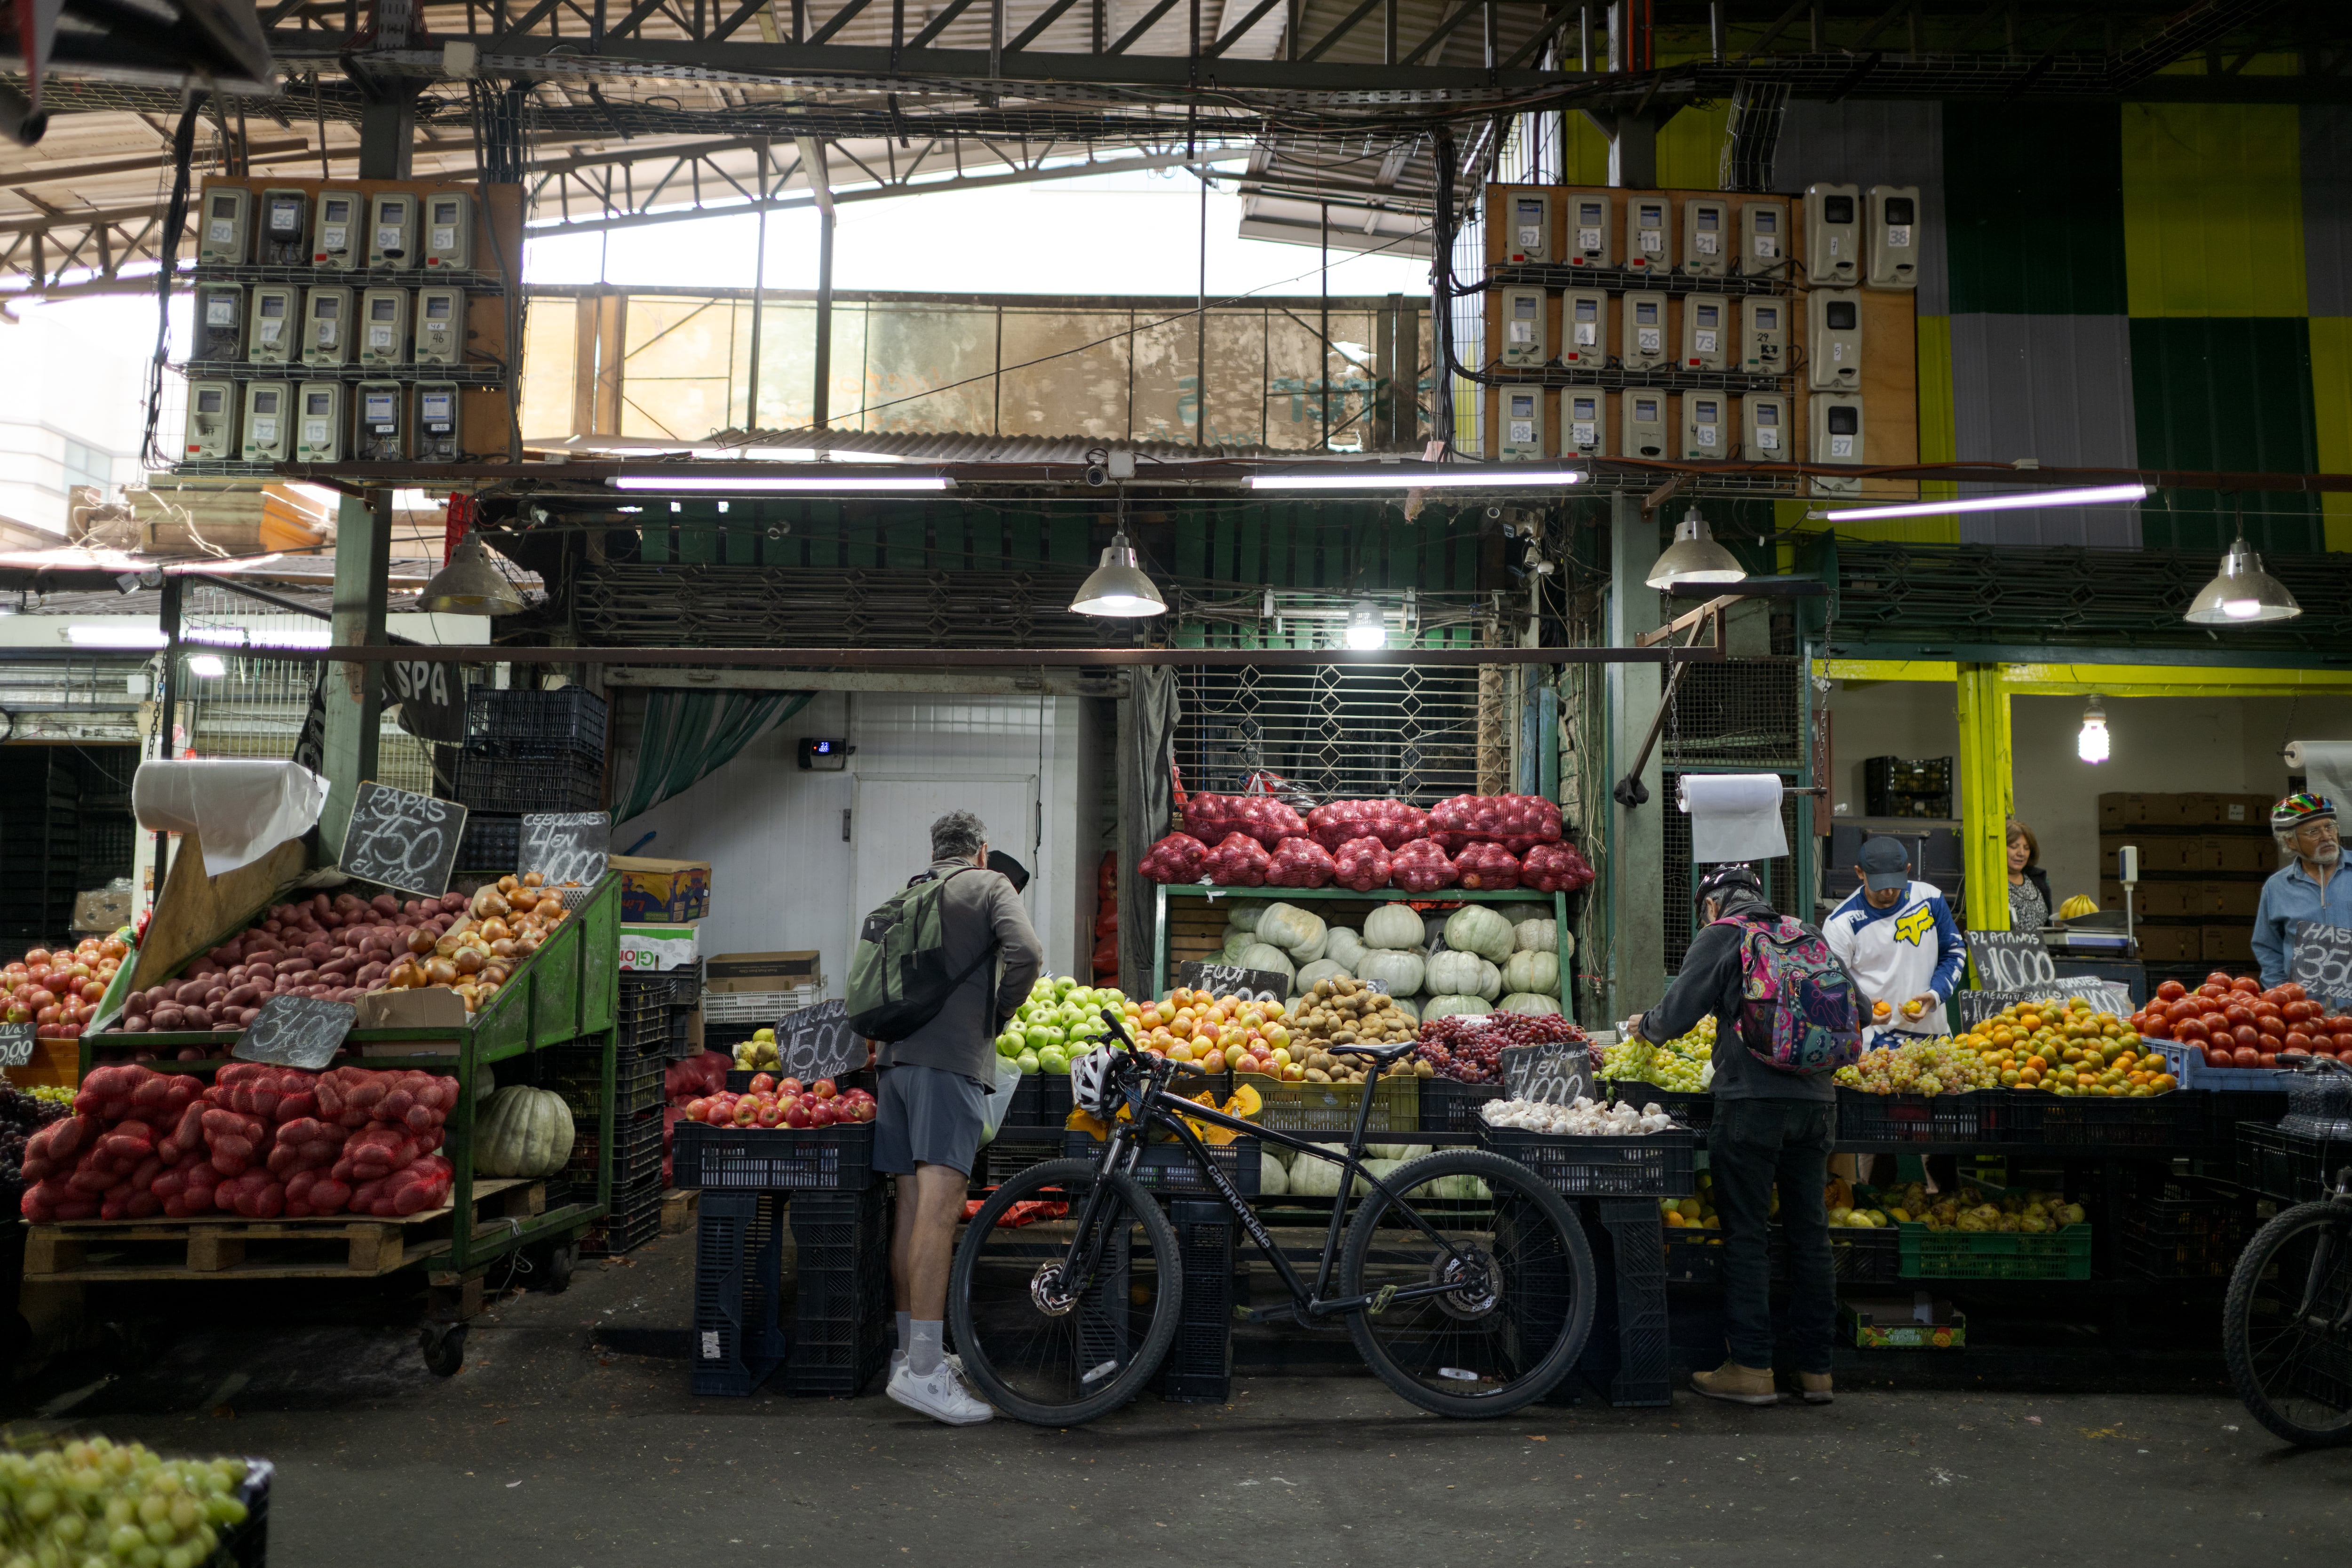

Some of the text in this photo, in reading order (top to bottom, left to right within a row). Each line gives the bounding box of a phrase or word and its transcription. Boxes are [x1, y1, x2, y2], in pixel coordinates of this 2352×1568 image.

[274, 214, 293, 227] 56
[212, 226, 231, 239] 50
[325, 232, 344, 245] 52
[379, 232, 398, 246] 90
[1520, 231, 1537, 244] 67
[1890, 230, 1908, 244] 38
[435, 234, 452, 247] 51
[1581, 233, 1598, 247] 13
[1642, 236, 1658, 249] 11
[1697, 238, 1714, 251] 21
[1760, 241, 1769, 254] 2
[318, 326, 328, 340] 9
[371, 330, 389, 344] 19
[1517, 326, 1524, 339] 1
[1579, 329, 1589, 342] 4
[1757, 333, 1769, 342] 29
[1640, 334, 1659, 347] 26
[1697, 335, 1715, 349] 73
[1835, 347, 1840, 356] 5
[257, 423, 273, 438] 32
[307, 425, 323, 438] 15
[1512, 426, 1531, 439] 68
[1574, 428, 1593, 441] 35
[1698, 430, 1715, 444] 43
[1762, 433, 1772, 446] 3
[1832, 440, 1851, 454] 37
[394, 661, 449, 706] SPA
[368, 787, 446, 822] PAPAS
[550, 833, 578, 848] EN
[1848, 910, 1868, 923] FOX
[1970, 931, 2039, 945] PLATANOS
[2055, 976, 2102, 989] TOMATES
[1537, 1043, 1564, 1058] AJO
[1511, 1054, 1561, 1084] 4 EN
[1207, 1164, 1271, 1249] cannondale
